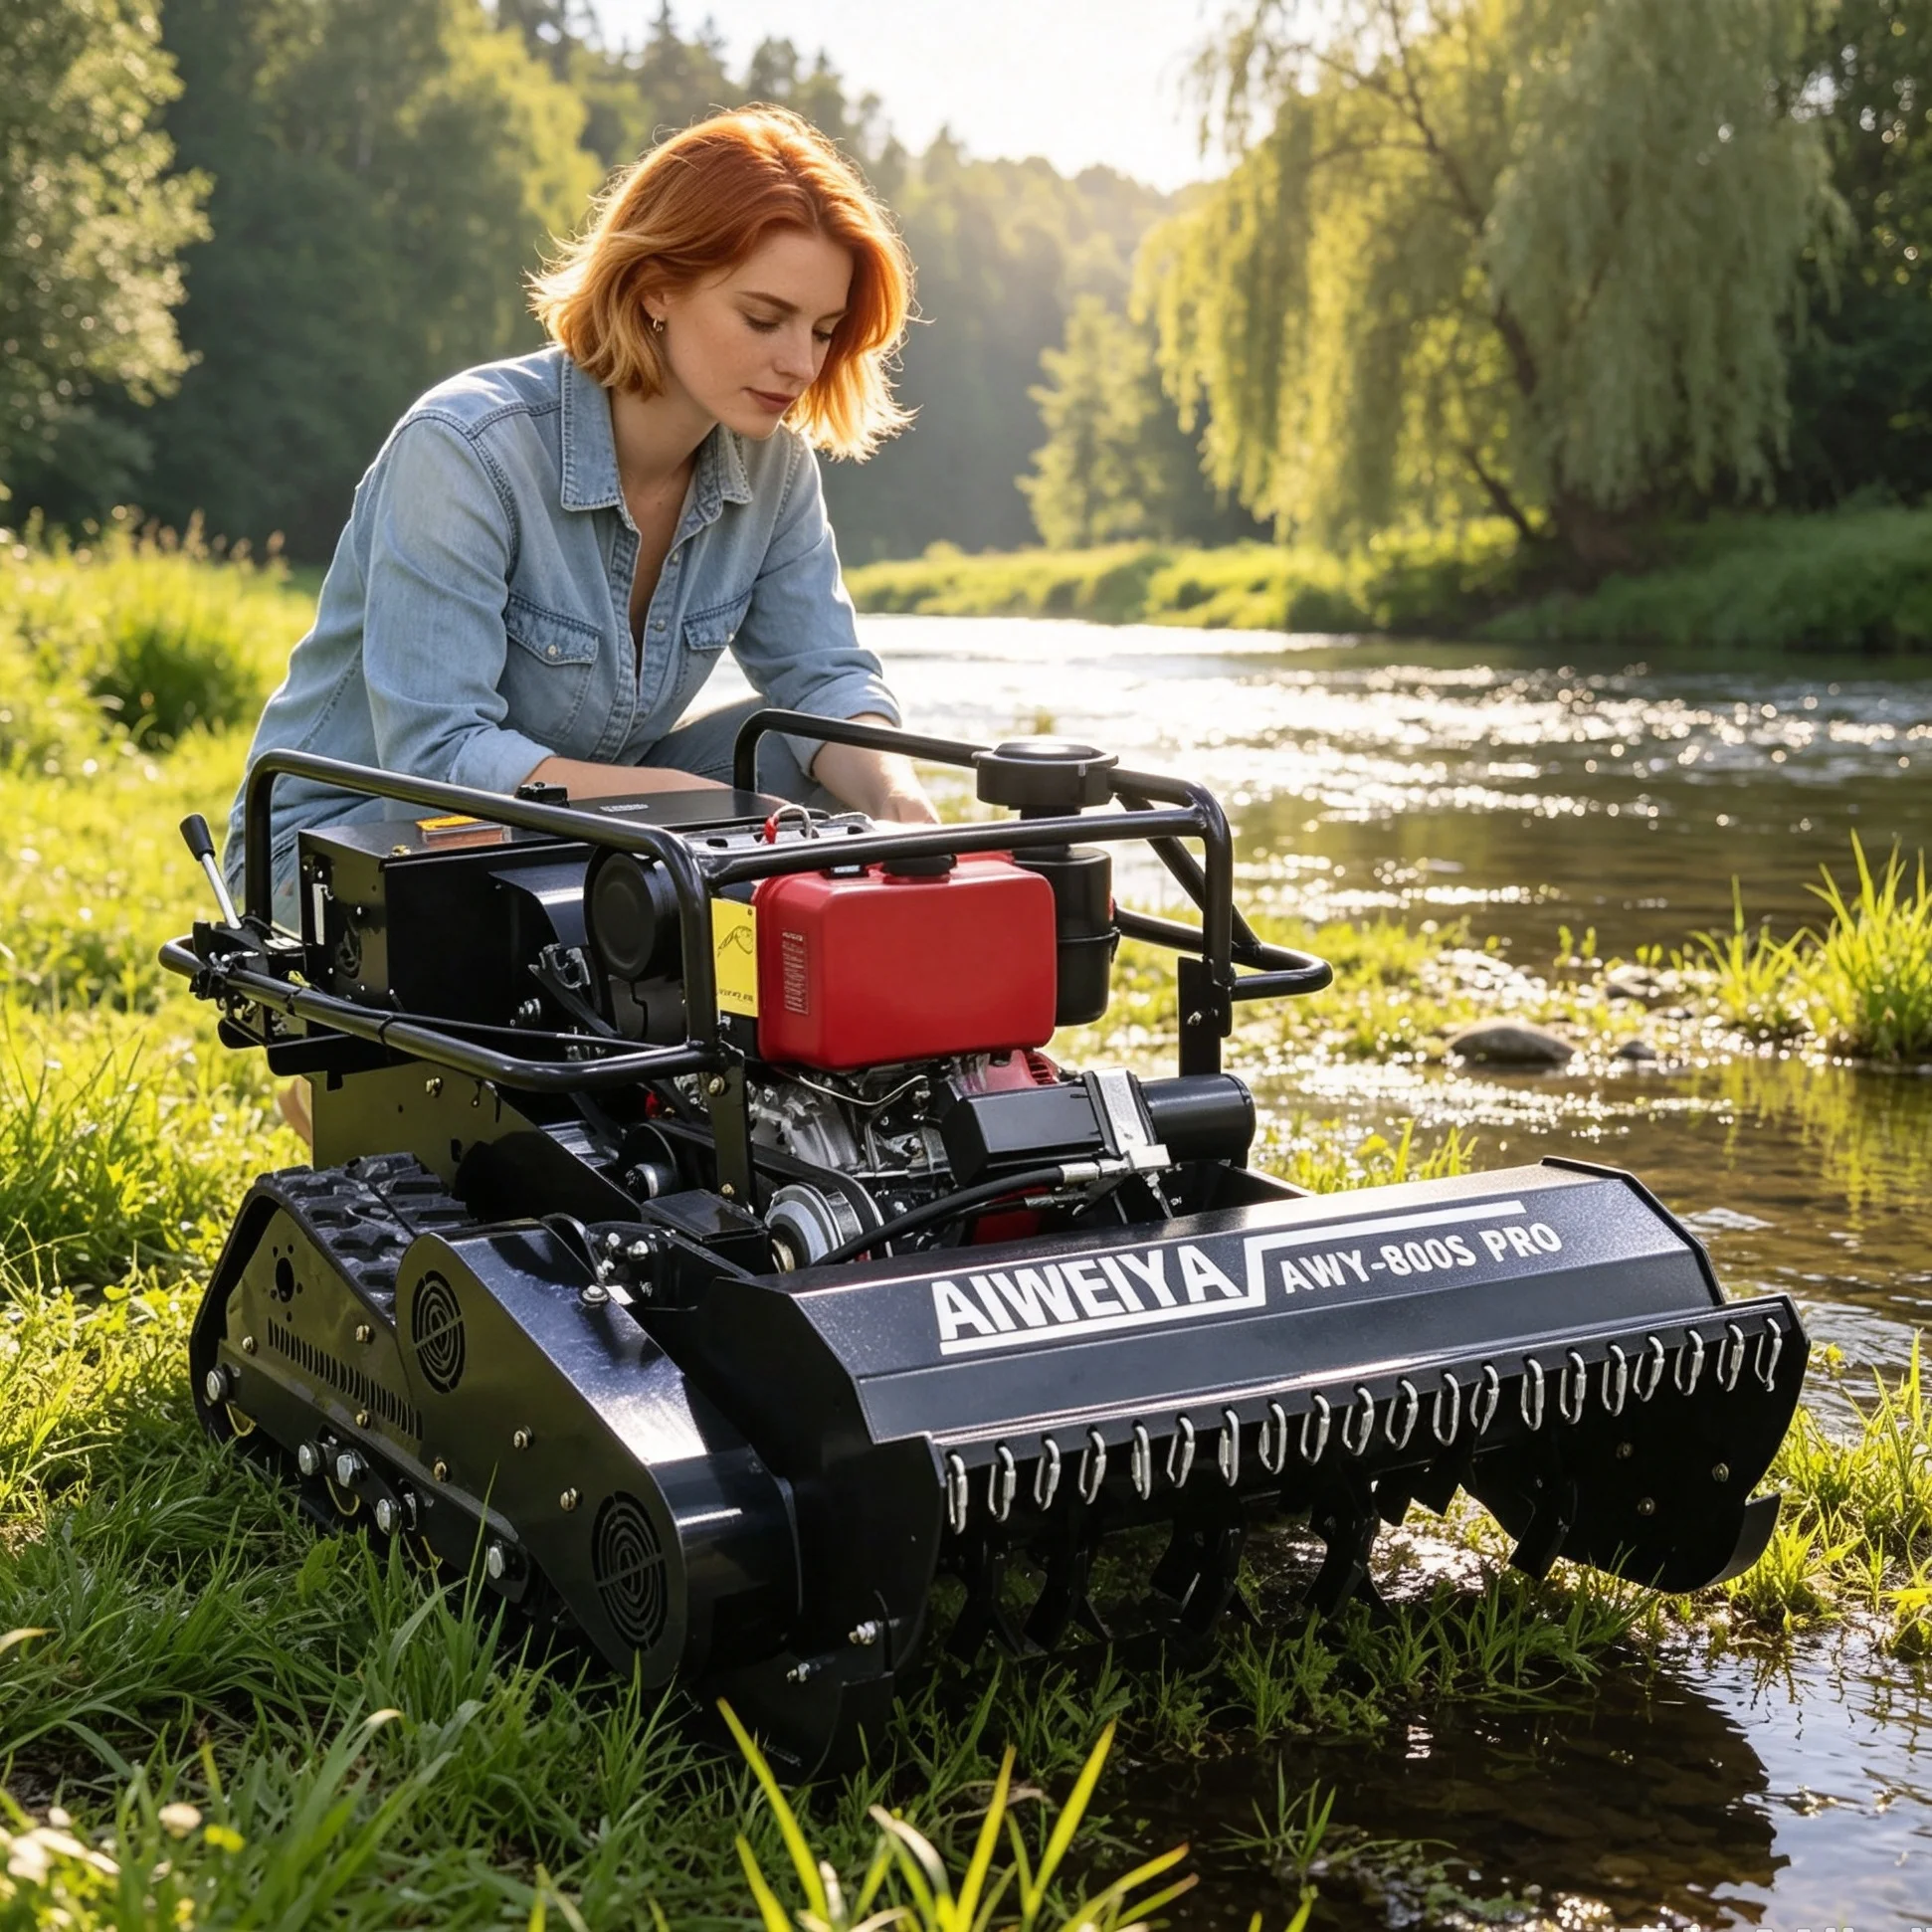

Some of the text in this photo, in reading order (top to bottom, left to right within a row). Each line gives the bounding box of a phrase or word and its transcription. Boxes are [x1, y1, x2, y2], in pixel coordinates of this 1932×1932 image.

[930, 1245, 1244, 1341] AIWEIYA
[1279, 1222, 1564, 1294] AWY-800S PRO
